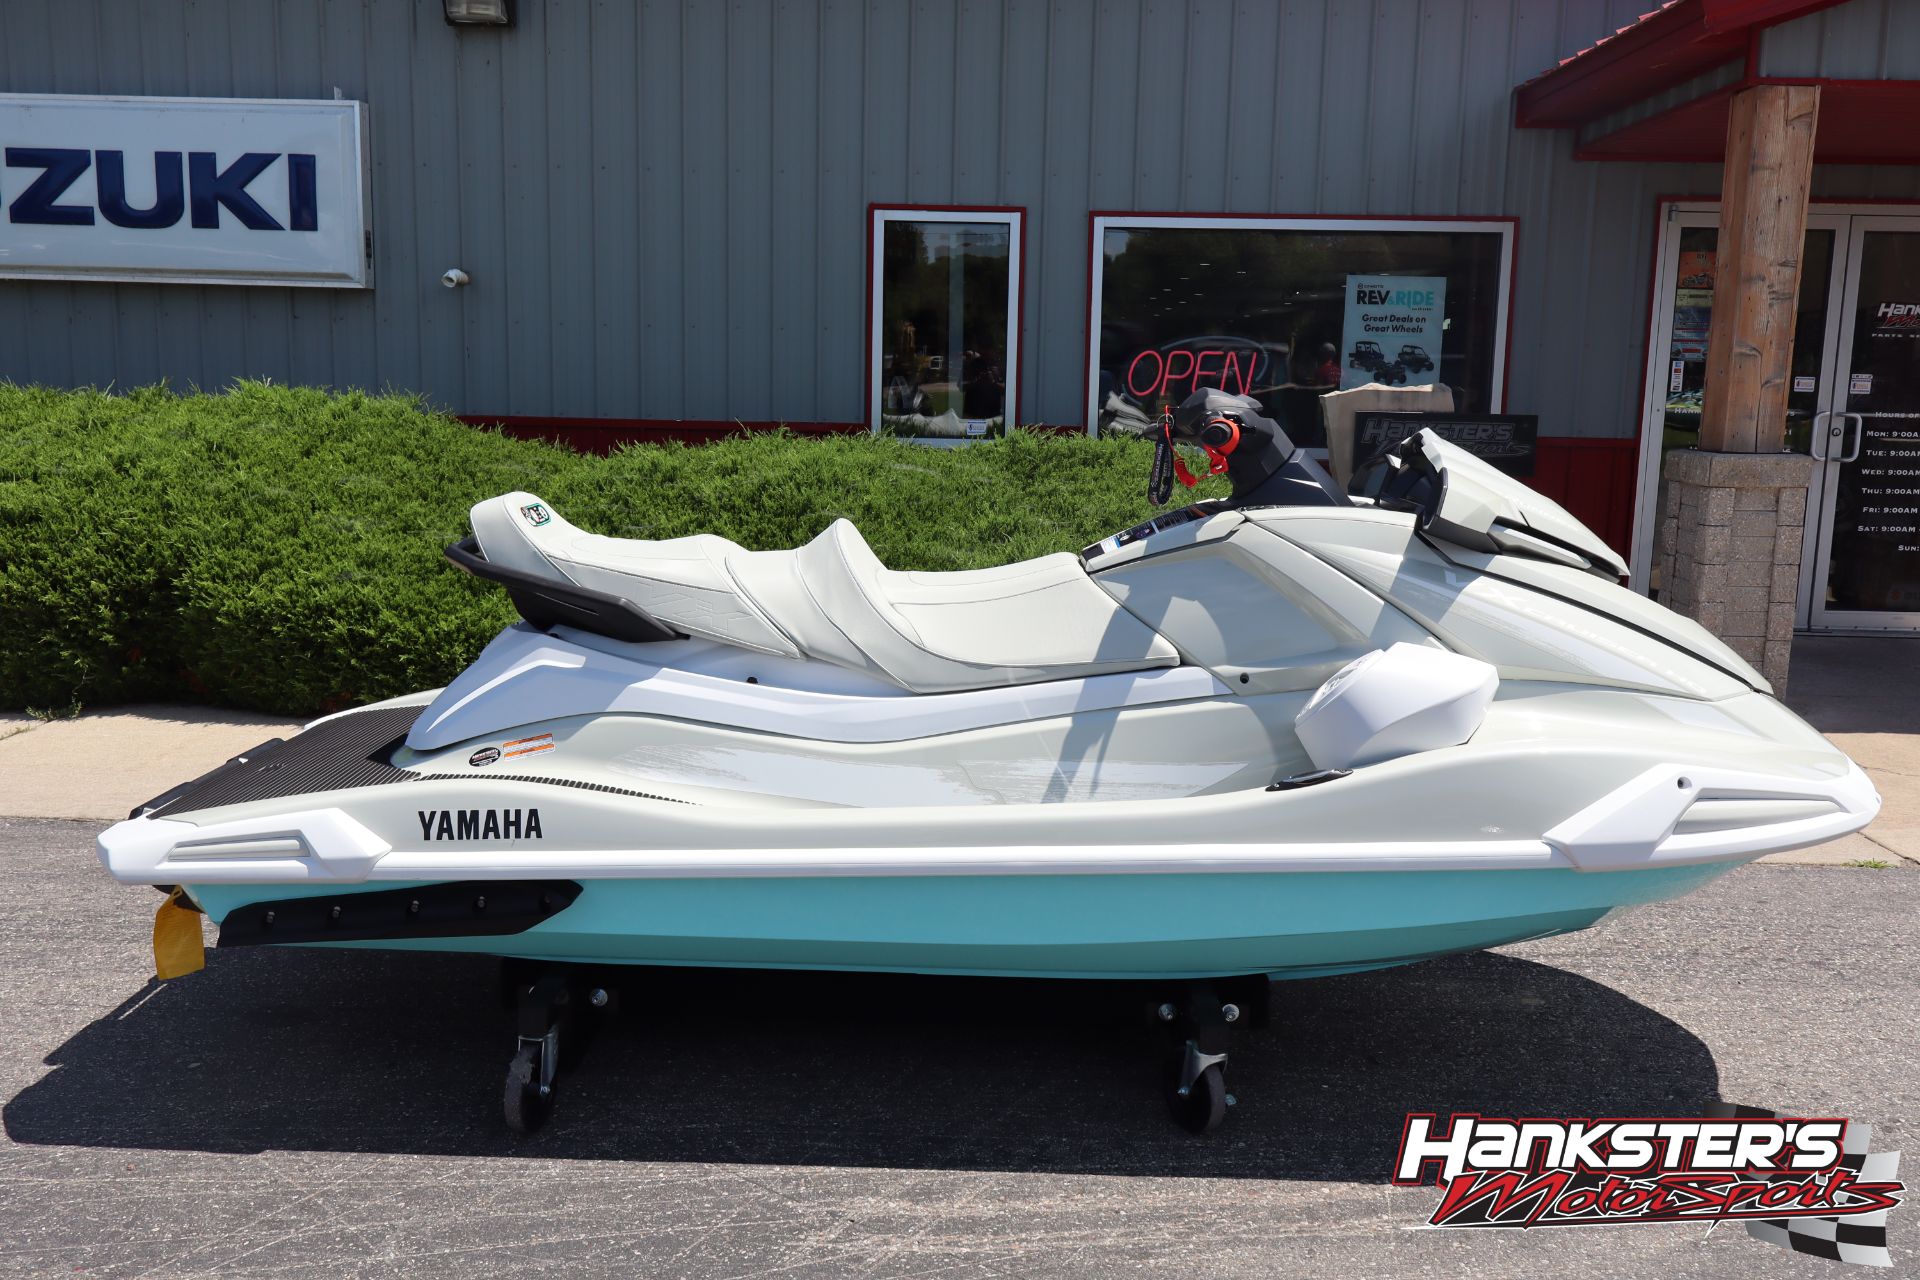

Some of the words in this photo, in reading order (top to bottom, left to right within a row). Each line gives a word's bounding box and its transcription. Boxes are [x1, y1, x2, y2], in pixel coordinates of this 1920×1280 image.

[0, 147, 318, 232] ZUKI
[1362, 314, 1387, 322] Great
[1389, 315, 1413, 323] Deals
[1364, 324, 1389, 332] Great
[1391, 325, 1423, 333] Wheels
[1127, 350, 1257, 396] OPEN
[1875, 411, 1906, 419] HOURS
[1866, 430, 1889, 438] MON:
[1866, 449, 1887, 457] TUE:
[1861, 468, 1885, 476] WED:
[1862, 487, 1883, 495] THU:
[1881, 525, 1916, 533] 9:00AM
[1897, 544, 1920, 552] SUN:
[418, 808, 542, 841] YAMAHA
